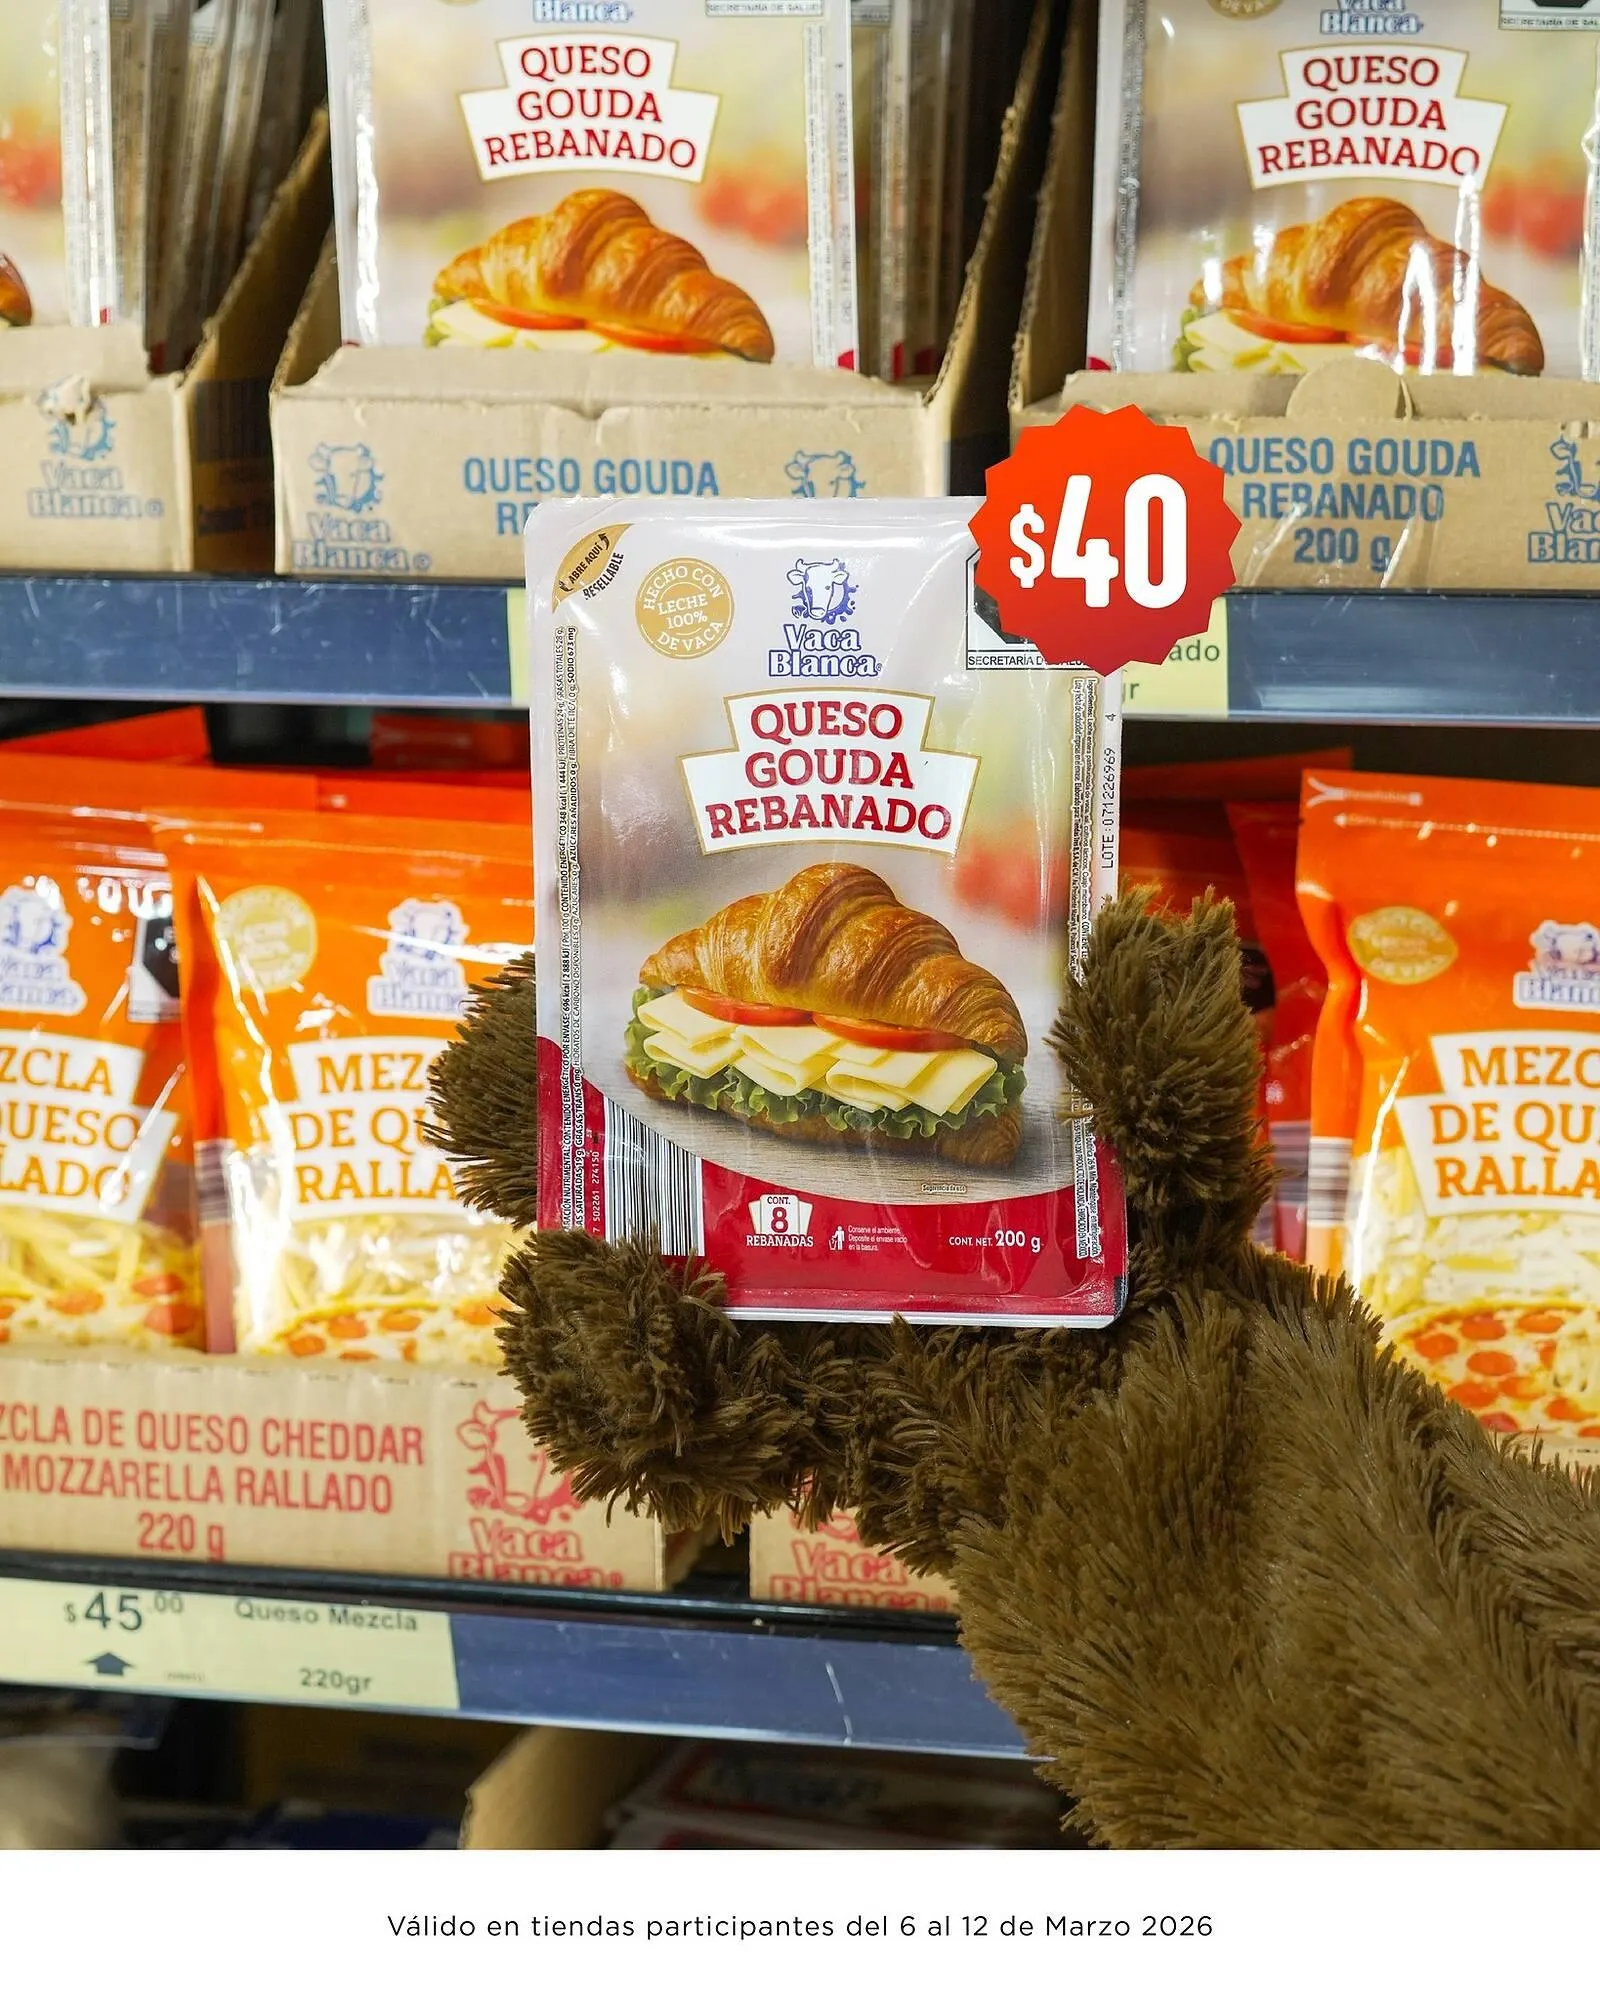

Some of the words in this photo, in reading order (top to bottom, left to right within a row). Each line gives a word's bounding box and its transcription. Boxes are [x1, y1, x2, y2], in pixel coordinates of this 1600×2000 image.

[1320, 10, 1420, 35] Blanca
[520, 45, 651, 82] QUESO
[1302, 55, 1440, 92] QUESO
[516, 88, 663, 123] GOUDA
[1295, 97, 1447, 131] GOUDA
[483, 128, 697, 169] REBANADO
[1257, 136, 1480, 176] REBANADO
[1209, 437, 1334, 478] QUESO
[1347, 438, 1481, 479] GOUDA
[463, 457, 580, 495] QUESO
[593, 459, 720, 497] GOUDA
[1242, 482, 1444, 522] REBANADO
[306, 512, 391, 543] Vaca
[293, 540, 410, 571] Blanca
[568, 560, 588, 584] ABRE
[584, 542, 603, 565] AQUÍ
[1293, 527, 1359, 564] 200
[1369, 534, 1392, 572] g
[582, 552, 625, 601] RESELLABLE
[643, 565, 688, 610] HECHO
[691, 567, 723, 599] CON
[657, 593, 708, 616] LECHE
[665, 611, 708, 630] 100%
[555, 634, 563, 644] 28
[567, 627, 577, 641] mg
[567, 641, 575, 657] 673
[657, 631, 680, 650] DE
[682, 620, 724, 651] VACA
[783, 624, 861, 652] Vaca
[555, 645, 564, 674] TOTALES
[567, 657, 575, 683] SODIO
[768, 649, 877, 678] Blanca
[968, 653, 1034, 666] SECRETARÍA
[1086, 679, 1097, 718] Ingredientes:
[750, 700, 903, 746] QUESO
[1087, 718, 1095, 736] Leche
[1105, 713, 1117, 722] 4
[556, 719, 566, 756] PROTEÍNAS
[1086, 736, 1094, 754] entera
[744, 749, 914, 790] GOUDA
[1084, 755, 1093, 790] pasteurizada
[558, 796, 567, 810] kcal
[568, 776, 578, 819] AÑADIDOS
[559, 811, 567, 825] 348
[704, 794, 953, 840] REBANADO
[1072, 818, 1081, 837] Tiendas
[558, 826, 569, 869] ENERGÉTICO
[1083, 825, 1092, 848] cultivos
[560, 870, 570, 912] CONTENIDO
[561, 919, 570, 930] 100
[572, 931, 580, 979] DISPONIBLES
[562, 983, 570, 998] kcal
[562, 998, 570, 1012] 696
[562, 1013, 570, 1044] ENVASE:
[573, 1019, 580, 1028] DE
[562, 1045, 570, 1058] POR
[573, 1030, 581, 1066] HIDRATOS
[0, 1047, 114, 1097] ZCLA
[316, 1052, 425, 1095] MEZ
[561, 1060, 571, 1103] ENERGÉTICO
[1458, 1045, 1600, 1089] MEZC
[575, 1090, 584, 1113] TRANS
[3, 1101, 141, 1153] UESO
[288, 1107, 356, 1150] DE
[562, 1104, 571, 1146] CONTENIDO
[575, 1114, 584, 1146] GRASAS
[1429, 1101, 1501, 1147] DE
[0, 1143, 131, 1205] LADO
[575, 1157, 583, 1166] 19
[591, 1151, 600, 1184] 274150
[1434, 1155, 1600, 1201] RALLA
[295, 1160, 457, 1205] RALLA
[575, 1167, 584, 1213] SATURADAS
[592, 1190, 600, 1222] 502261
[766, 1196, 791, 1205] CONT.
[770, 1207, 789, 1234] 8
[848, 1225, 871, 1234] Conserve
[746, 1234, 814, 1248] REBANADAS
[848, 1235, 870, 1243] Deposite
[948, 1236, 974, 1246] CONT.
[975, 1237, 993, 1247] NET.
[994, 1229, 1026, 1247] 200
[1030, 1236, 1041, 1253] g
[83, 1408, 124, 1447] DE
[137, 1410, 249, 1455] QUESO
[262, 1417, 425, 1465] CHEDDAR
[3, 1453, 225, 1504] MOZZARELLA
[236, 1467, 393, 1514] RALLADO
[137, 1511, 196, 1553] 220
[206, 1523, 226, 1562] g
[470, 1517, 583, 1562] Vaca
[791, 1540, 909, 1586] Vaca
[233, 1595, 320, 1626] Queso
[329, 1604, 418, 1633] Mezcla
[299, 1666, 372, 1696] 220gr
